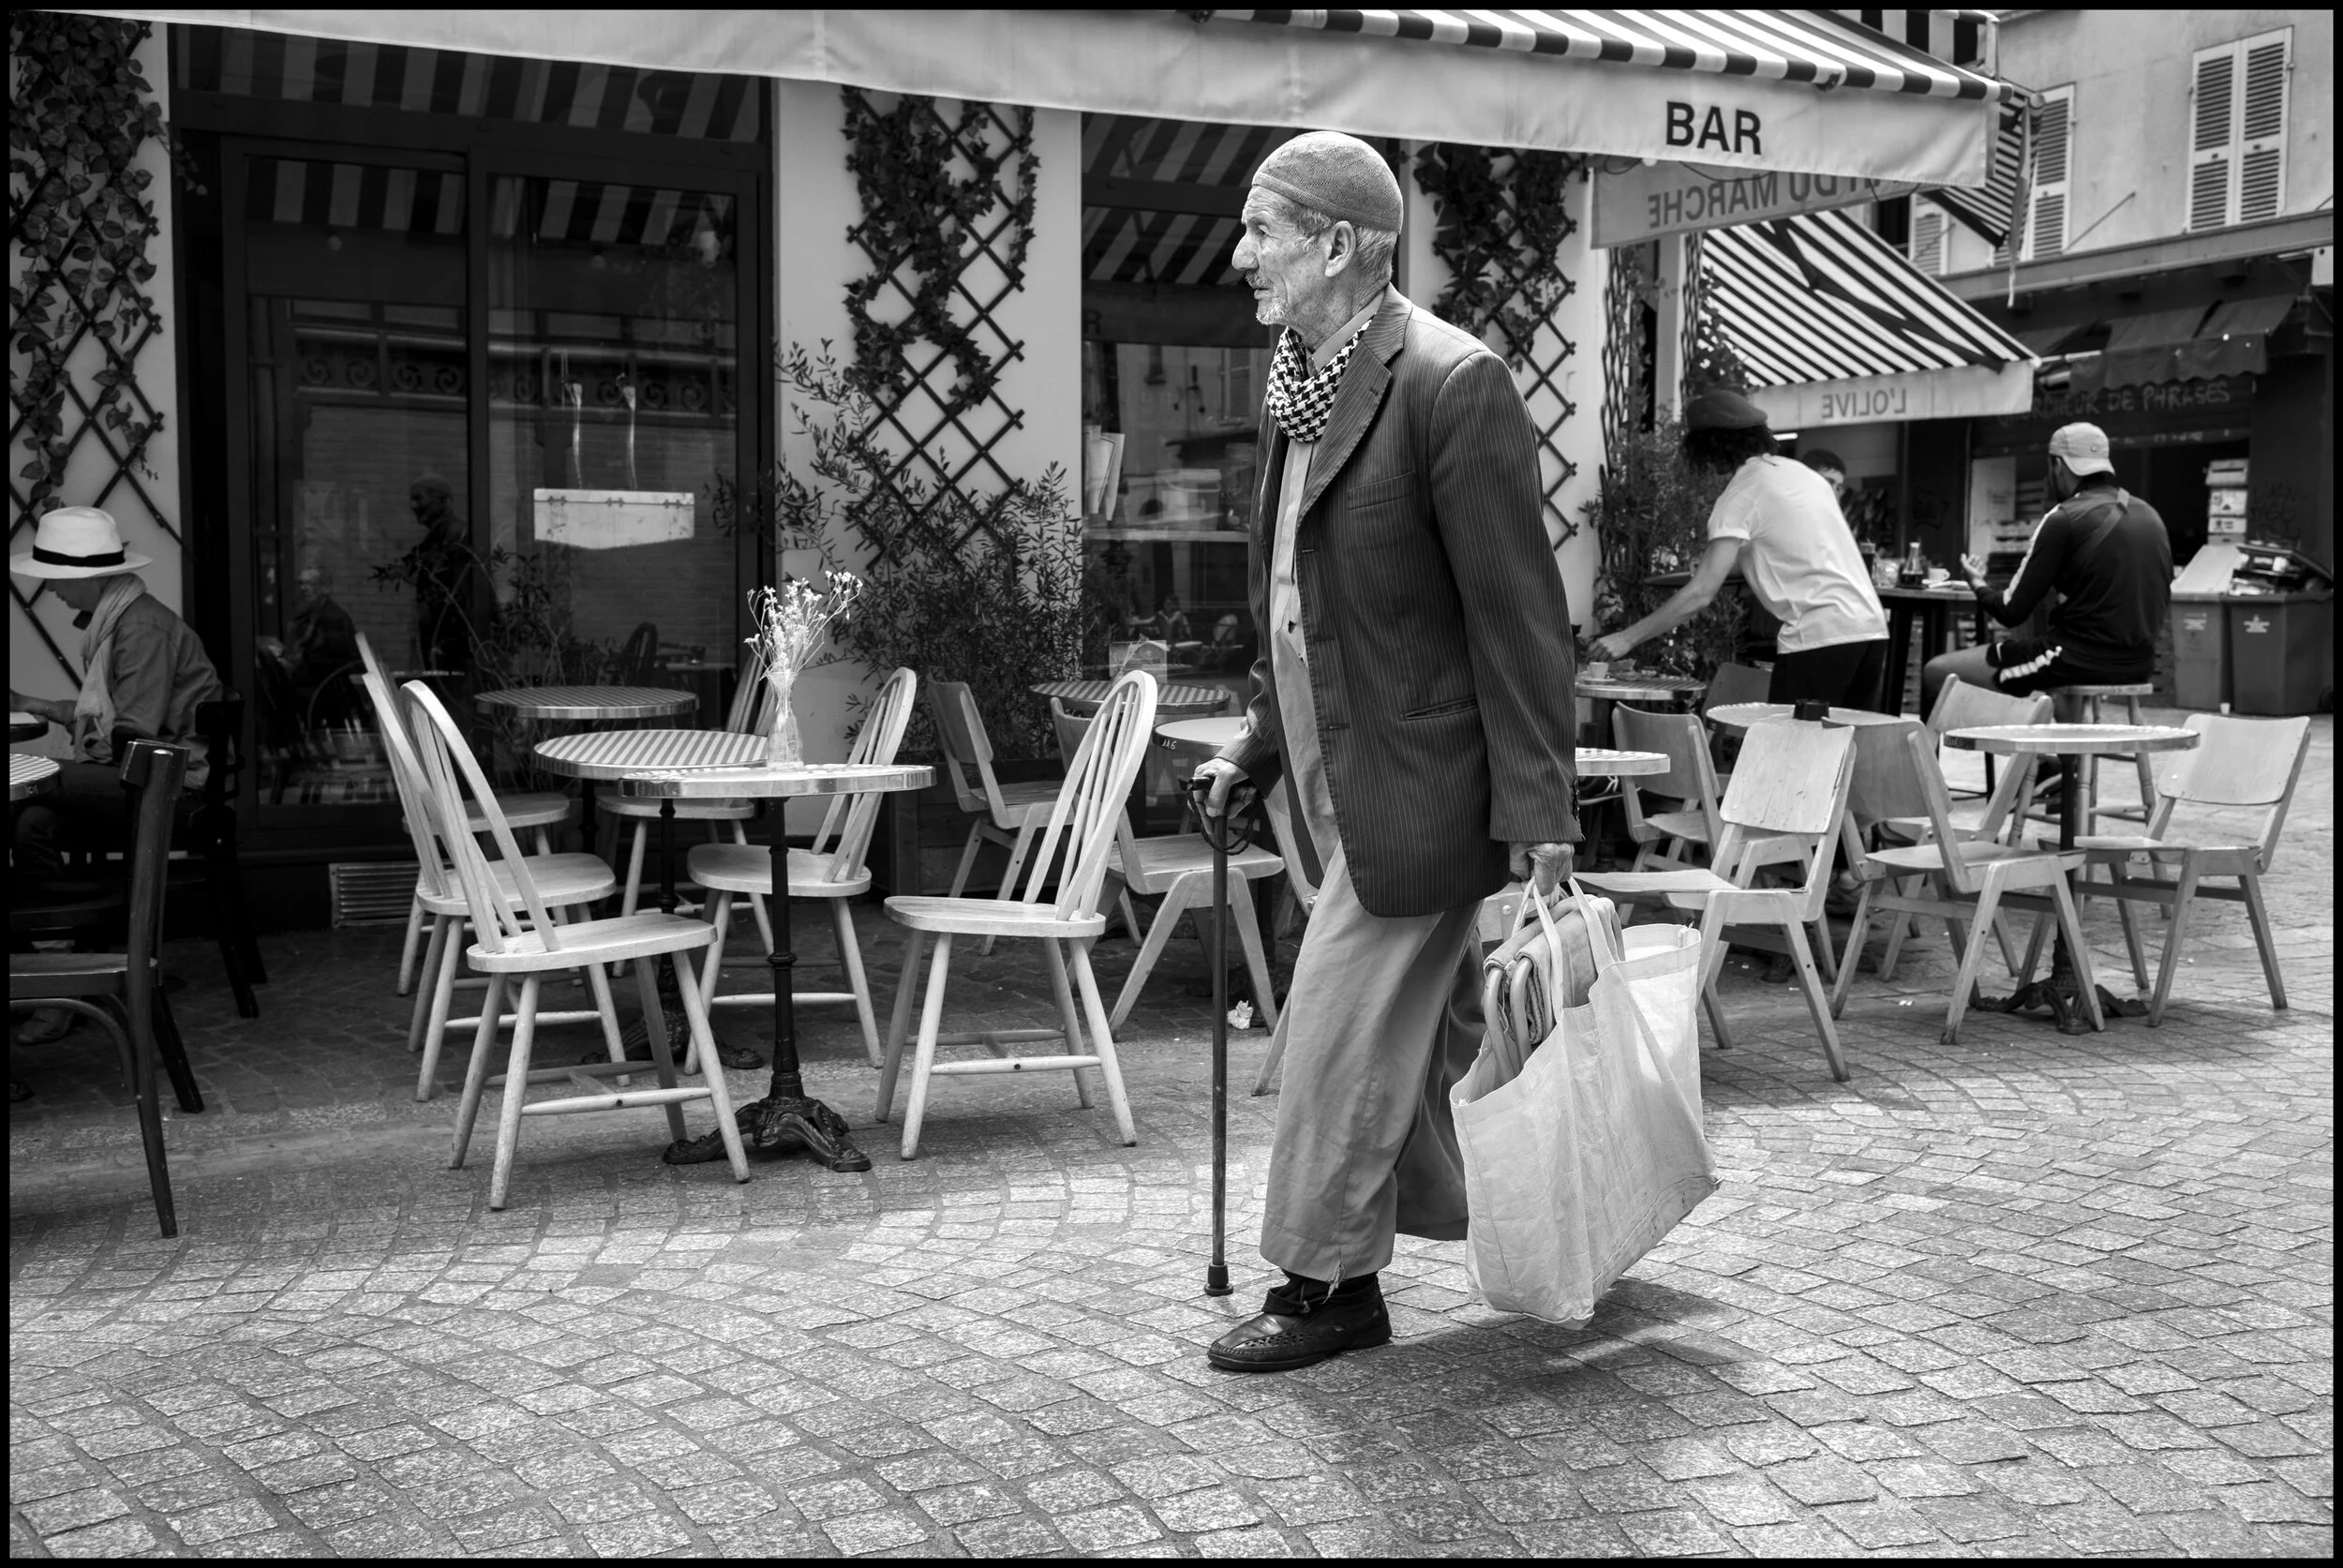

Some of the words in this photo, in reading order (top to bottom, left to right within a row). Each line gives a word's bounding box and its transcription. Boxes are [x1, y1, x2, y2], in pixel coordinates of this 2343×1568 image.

[1665, 100, 1762, 156] BAR
[2107, 389, 2135, 412] DE
[2142, 380, 2231, 412] PHRASES
[1161, 739, 1177, 750] 116
